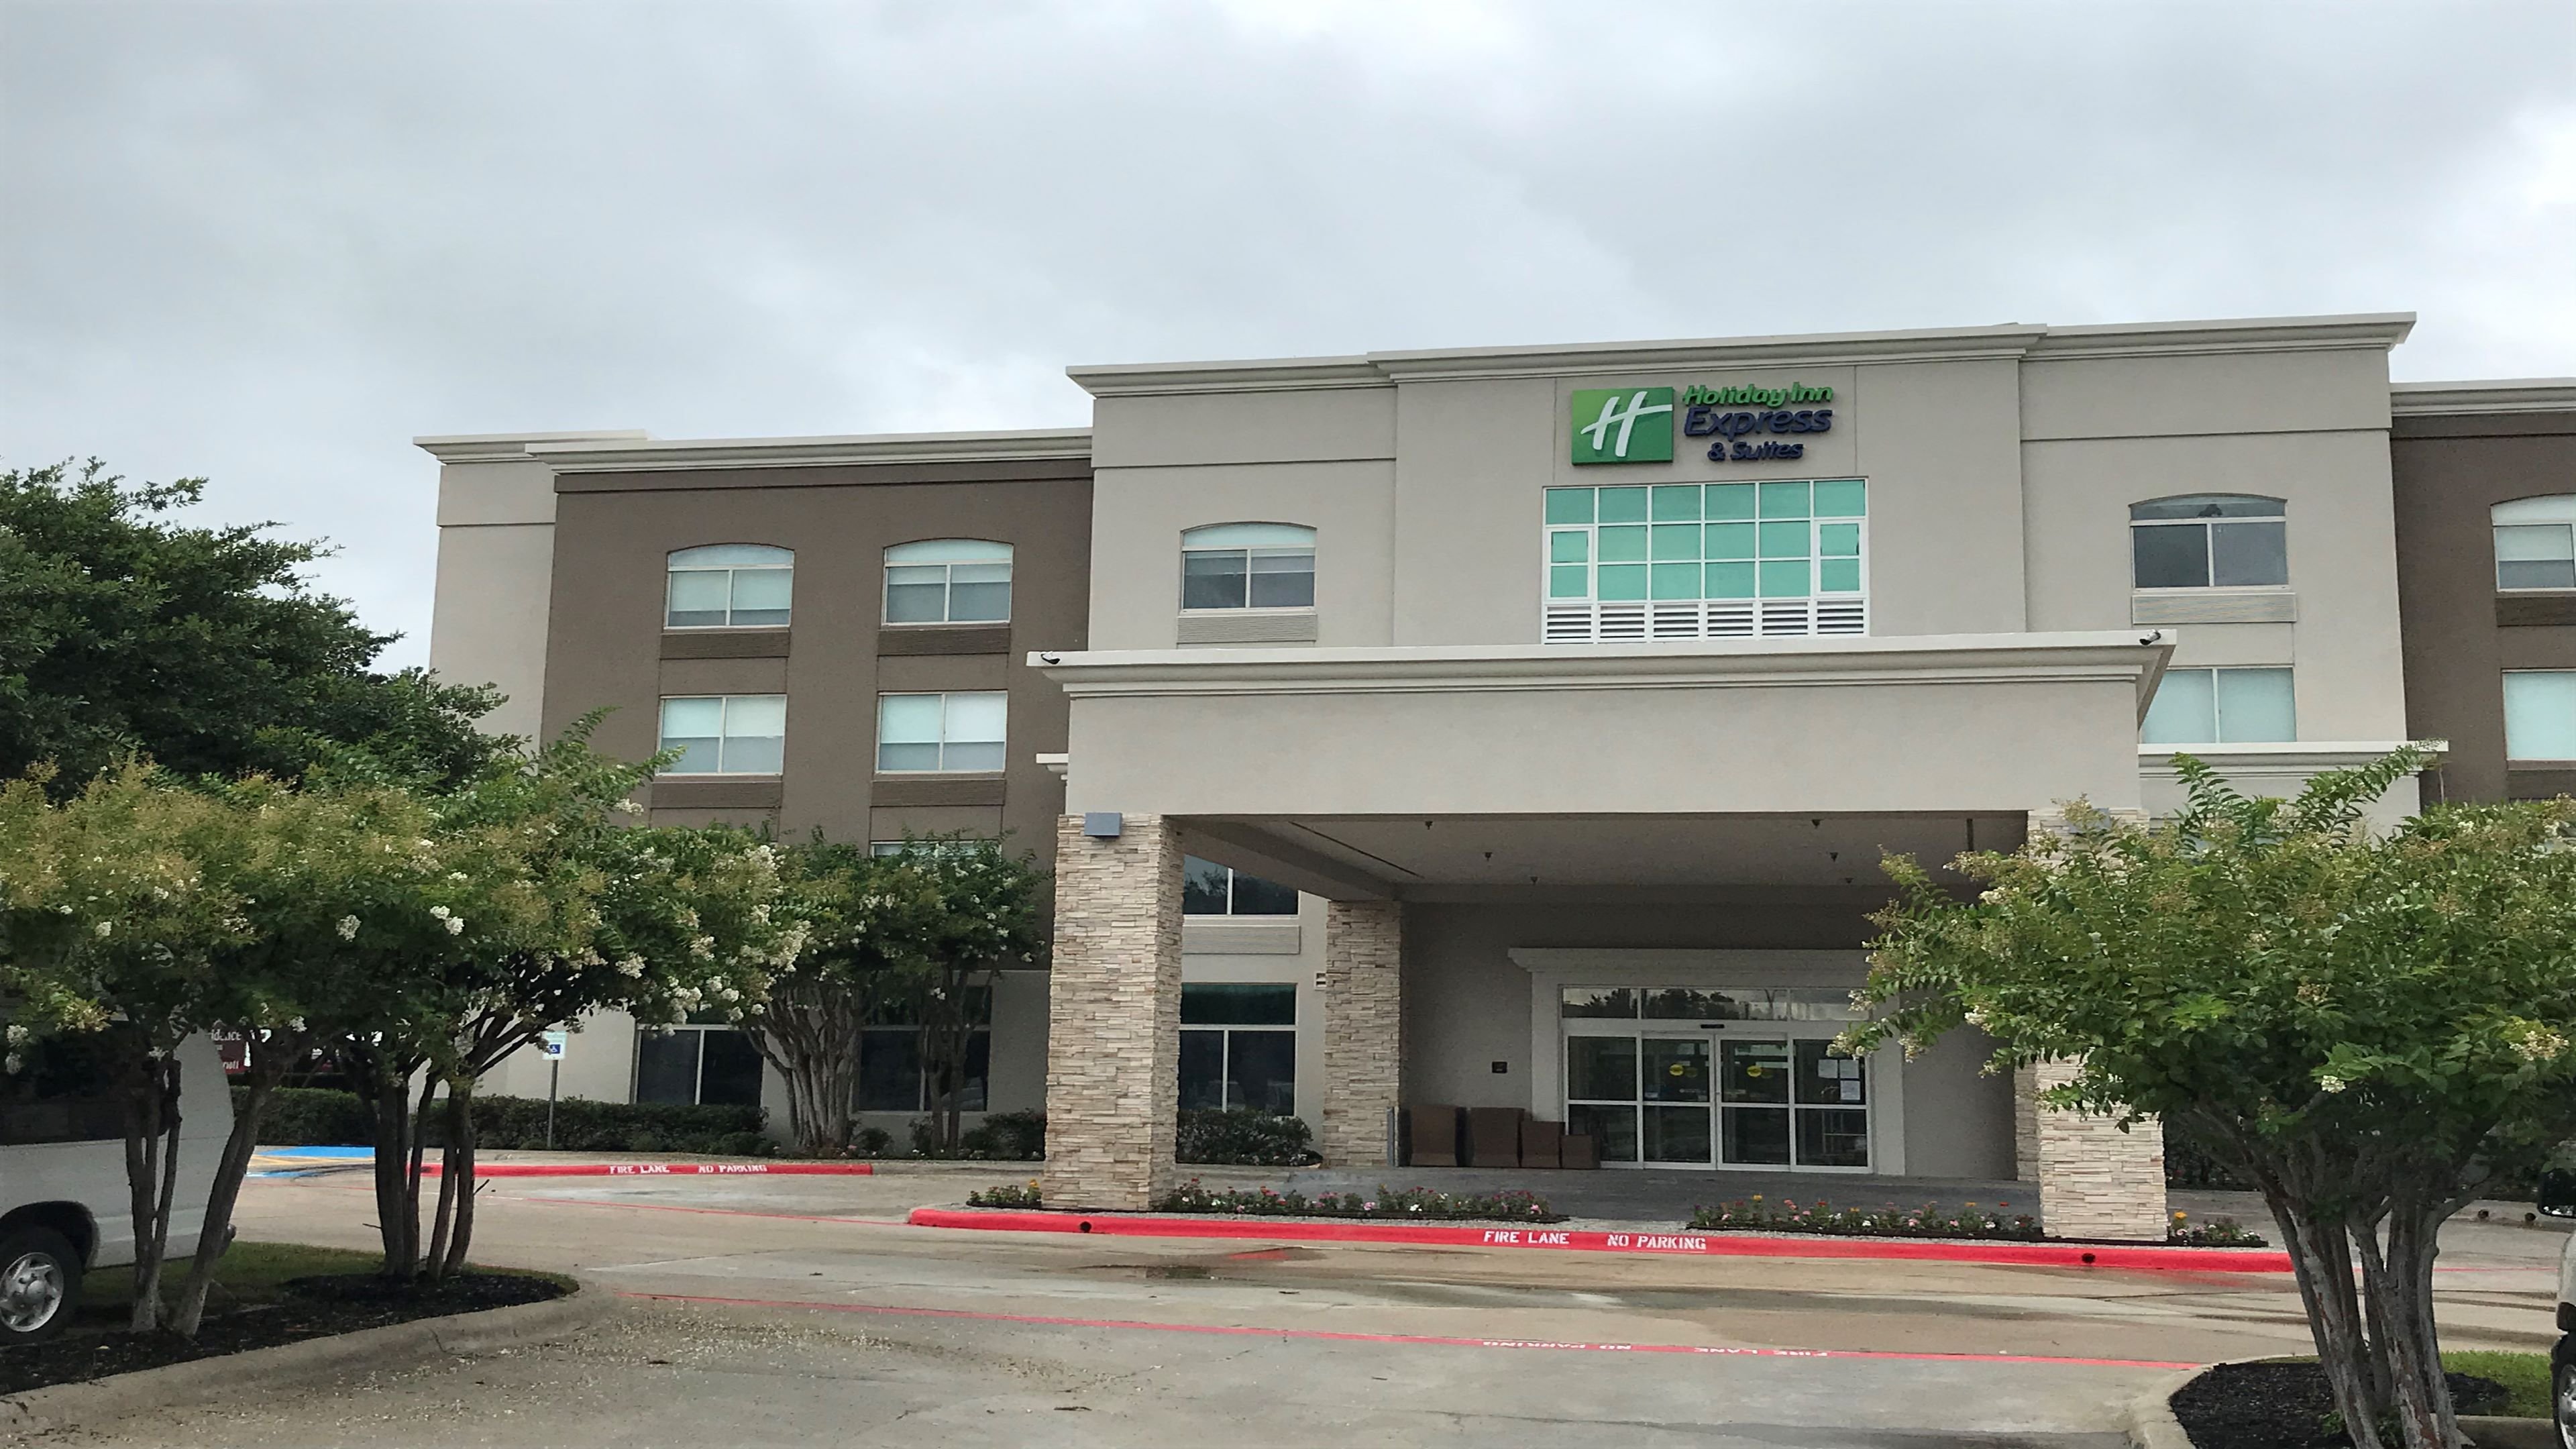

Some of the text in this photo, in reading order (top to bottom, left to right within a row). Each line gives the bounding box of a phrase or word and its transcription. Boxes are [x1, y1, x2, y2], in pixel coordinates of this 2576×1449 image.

[1682, 381, 1833, 408] Holiday Inn
[1684, 406, 1833, 441] Express
[1707, 441, 1804, 461] & Suites
[610, 1165, 768, 1174] FIRE LANE NO PARKING
[1483, 1231, 1707, 1250] FIRE LANE NO PARKING
